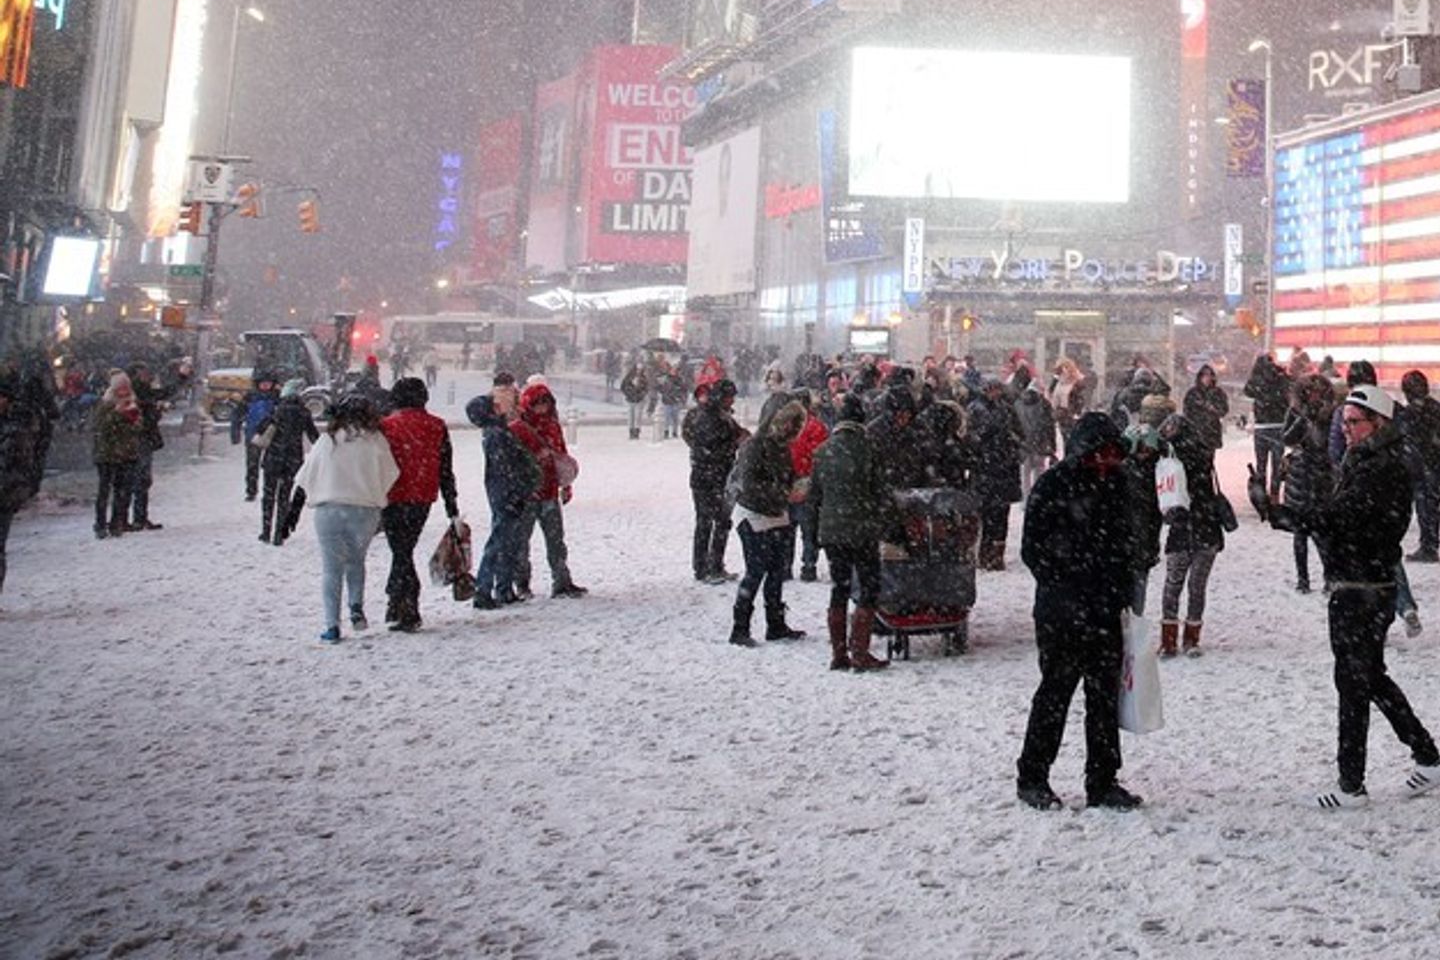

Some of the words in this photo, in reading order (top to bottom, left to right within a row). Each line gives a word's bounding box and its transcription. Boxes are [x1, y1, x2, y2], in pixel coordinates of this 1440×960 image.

[613, 170, 635, 185] OF
[643, 171, 692, 200] DA
[909, 220, 922, 288] NYPD
